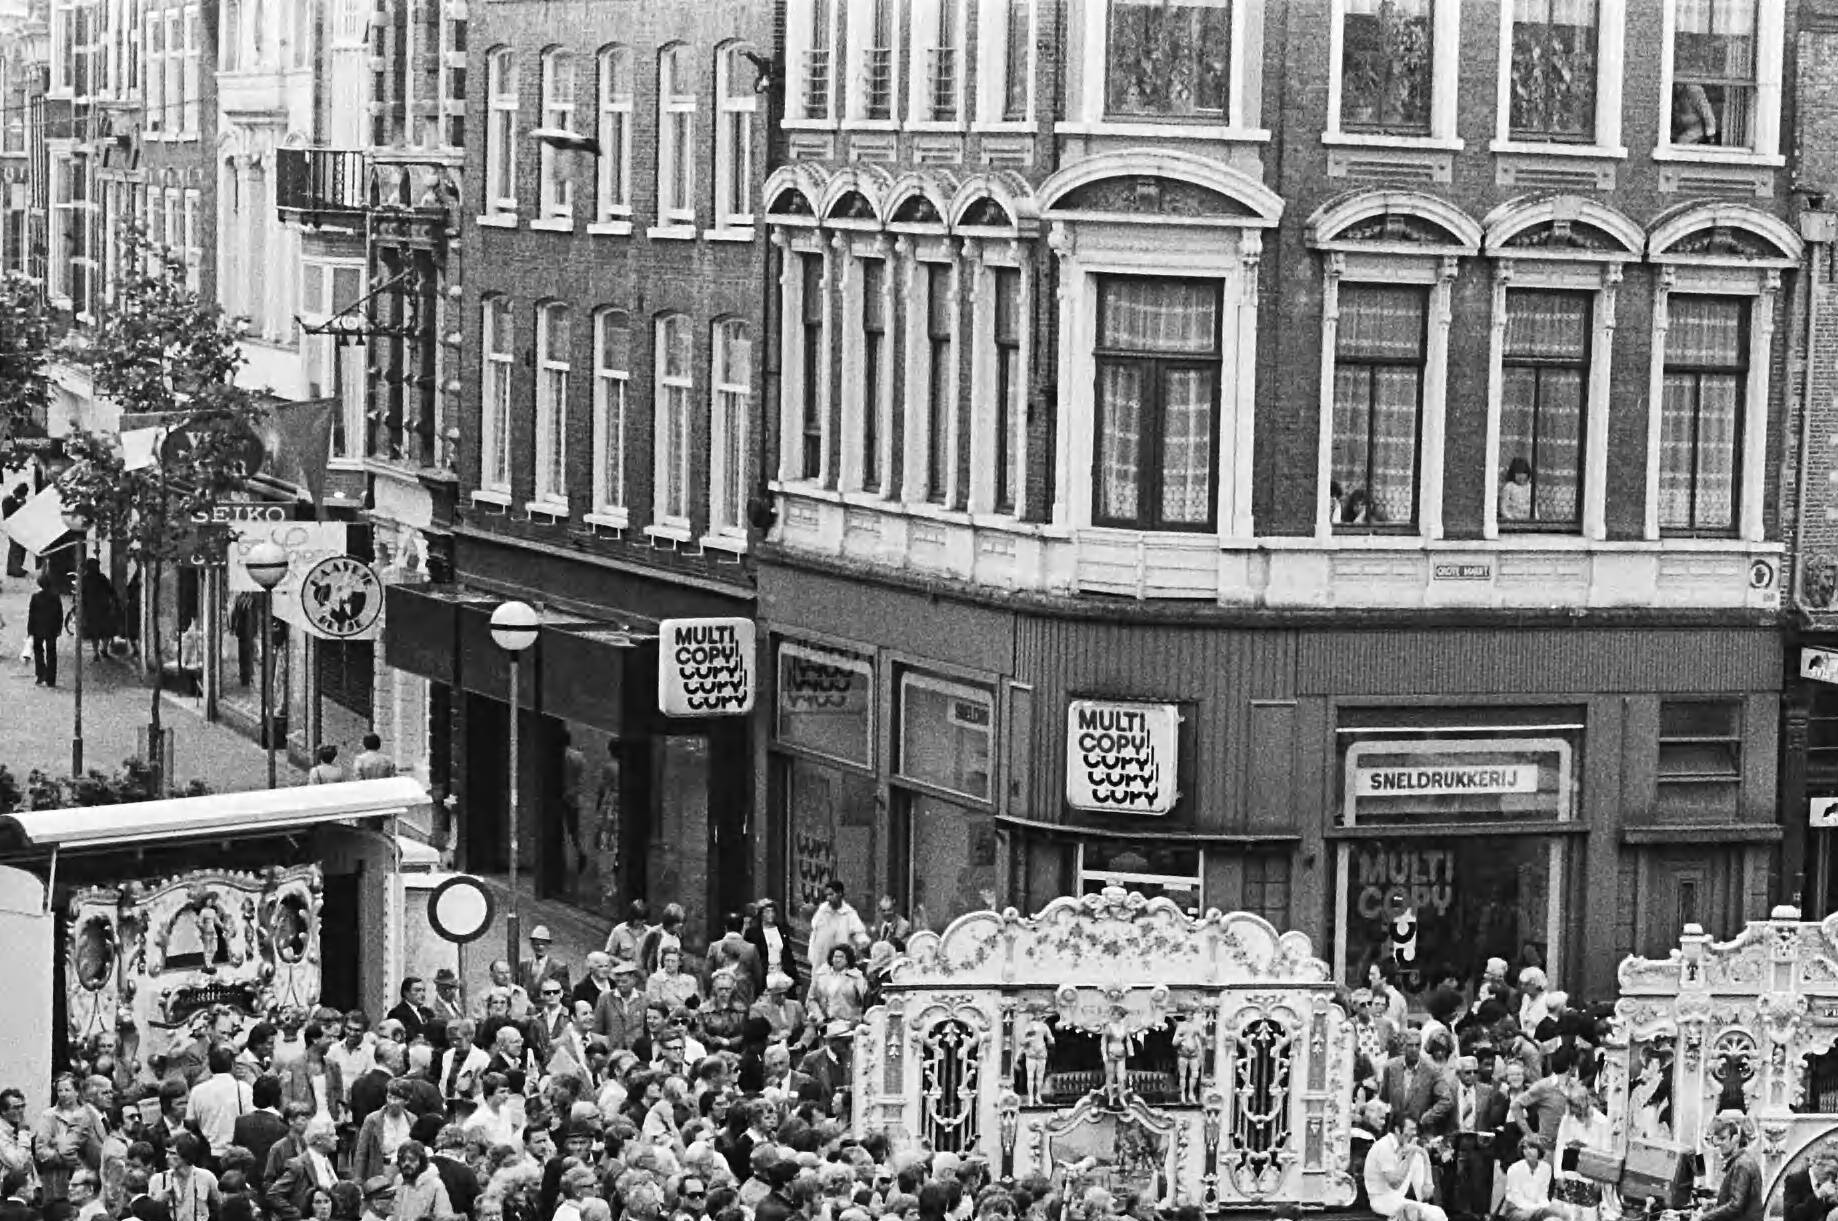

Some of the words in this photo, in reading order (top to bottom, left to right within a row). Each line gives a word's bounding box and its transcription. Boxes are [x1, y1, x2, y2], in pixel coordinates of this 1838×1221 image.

[191, 506, 286, 522] SEIKO
[675, 625, 734, 646] MULTI
[1078, 709, 1145, 733] MULTI
[1370, 770, 1518, 791] SNELDRUKKERIJ
[1359, 851, 1453, 884] MULTI
